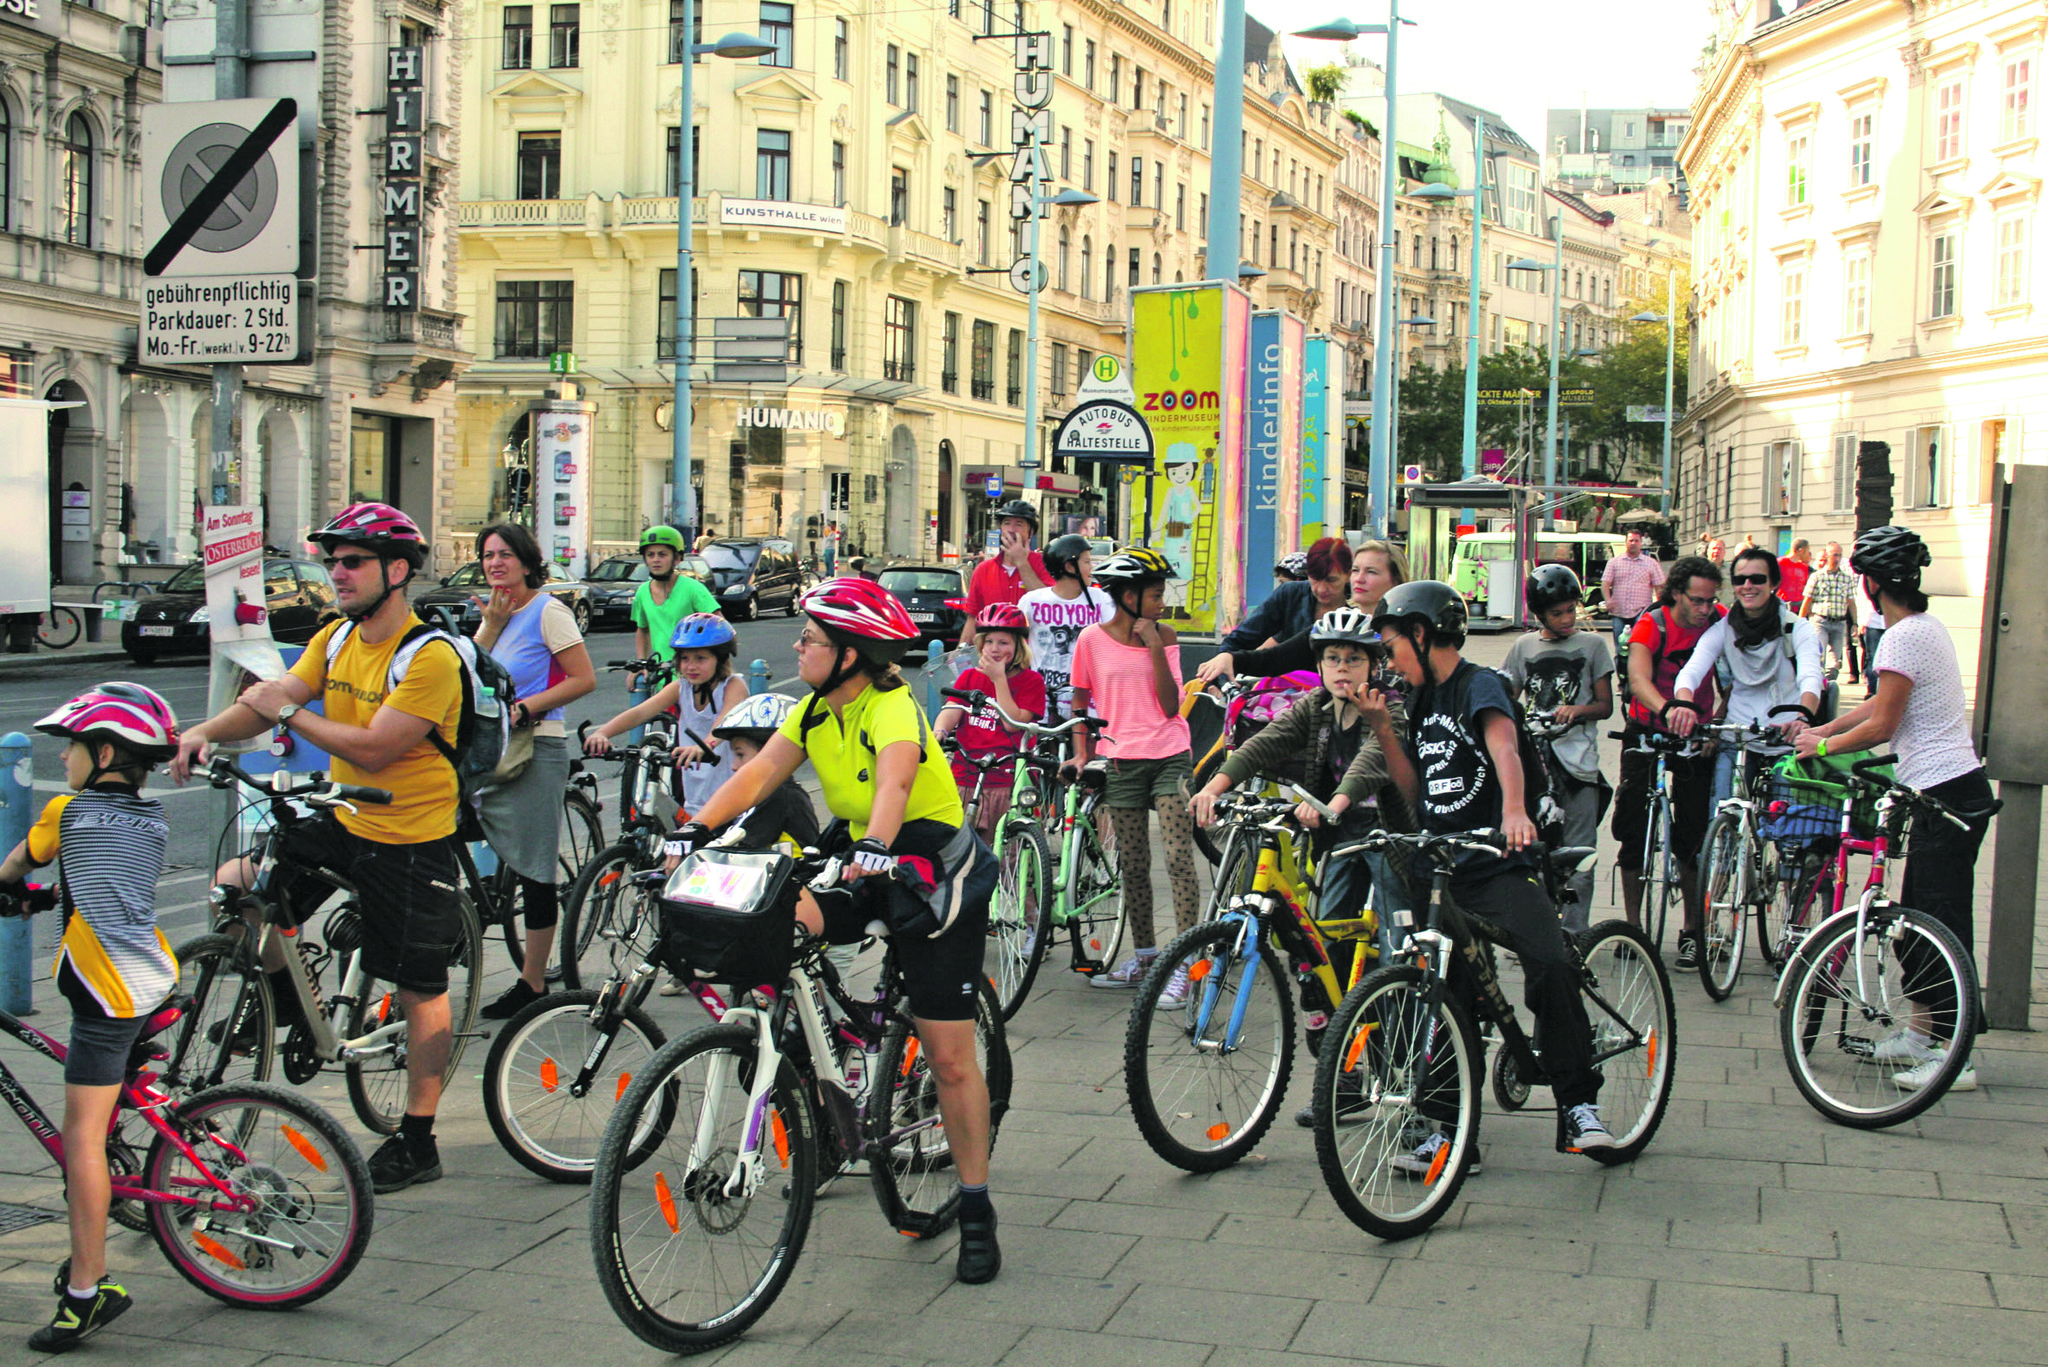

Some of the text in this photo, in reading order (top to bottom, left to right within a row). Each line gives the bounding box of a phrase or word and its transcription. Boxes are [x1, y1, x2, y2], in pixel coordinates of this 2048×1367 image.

[385, 50, 417, 306] HIRMER
[725, 206, 842, 225] KUNSTHALLE wien
[146, 280, 291, 309] gebührenpflichtig
[148, 307, 289, 331] Parkdauer: 2 Std.
[147, 335, 201, 356] Mo.-Fr.
[1100, 360, 1113, 377] H
[1477, 390, 1501, 398] ACKTE
[1078, 408, 1133, 428] AUTOBUS
[1255, 343, 1280, 510] kinderinfo
[1067, 437, 1141, 449] HALTESTELLE
[207, 510, 254, 531] Am Sonntag
[1031, 602, 1063, 625] ZOO
